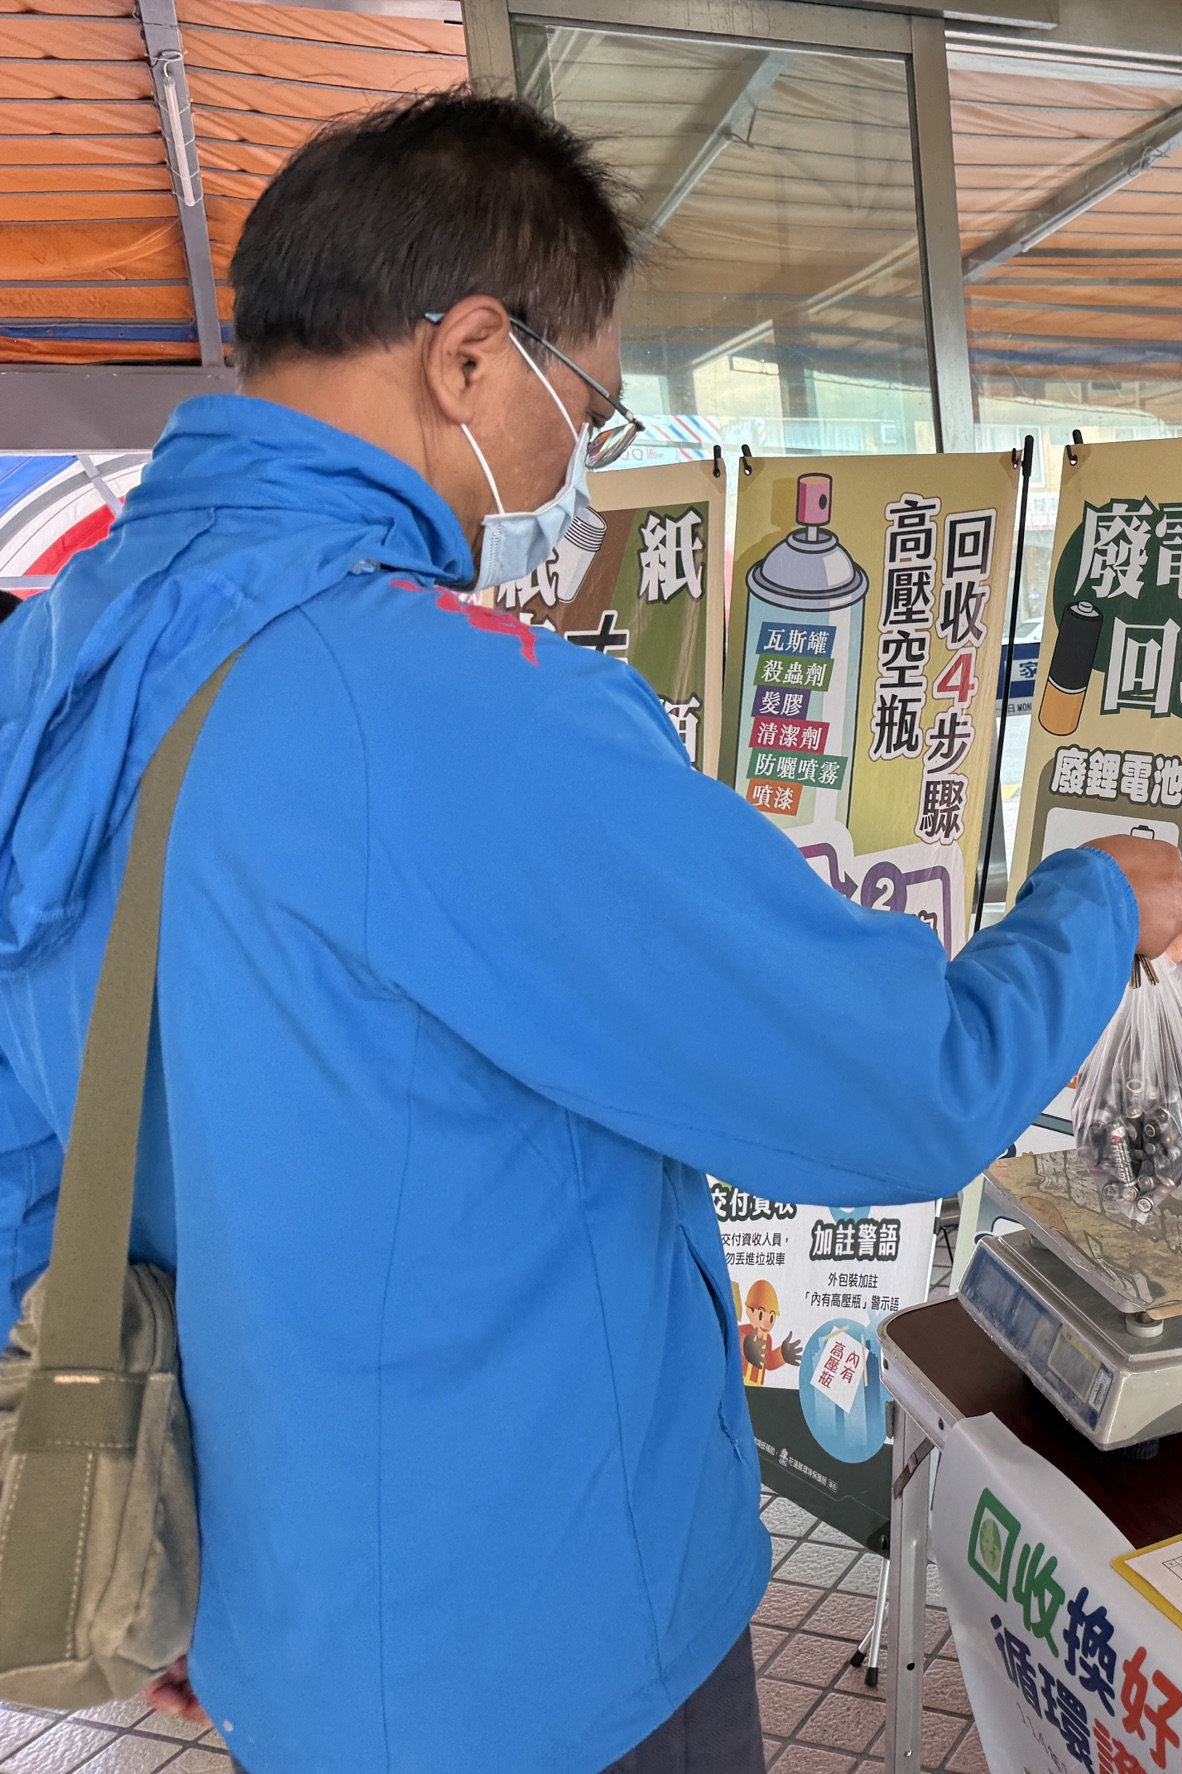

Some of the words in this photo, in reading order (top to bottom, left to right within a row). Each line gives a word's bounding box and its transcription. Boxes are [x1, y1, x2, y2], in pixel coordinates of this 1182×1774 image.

[763, 629, 829, 655] 瓦斯罐
[875, 499, 937, 757] 高壓空瓶
[761, 659, 827, 687] 殺蟲劑
[922, 513, 994, 840] 回收4步驟
[759, 690, 804, 716] 髮膠
[757, 722, 822, 750] 清潔劑
[754, 753, 841, 785] 防曬噴霧
[752, 784, 794, 810] 噴漆
[871, 877, 895, 911] 2
[812, 1223, 898, 1257] 加註警語
[828, 1272, 879, 1289] 外包裝加註
[818, 1341, 846, 1389] 高壓瓶
